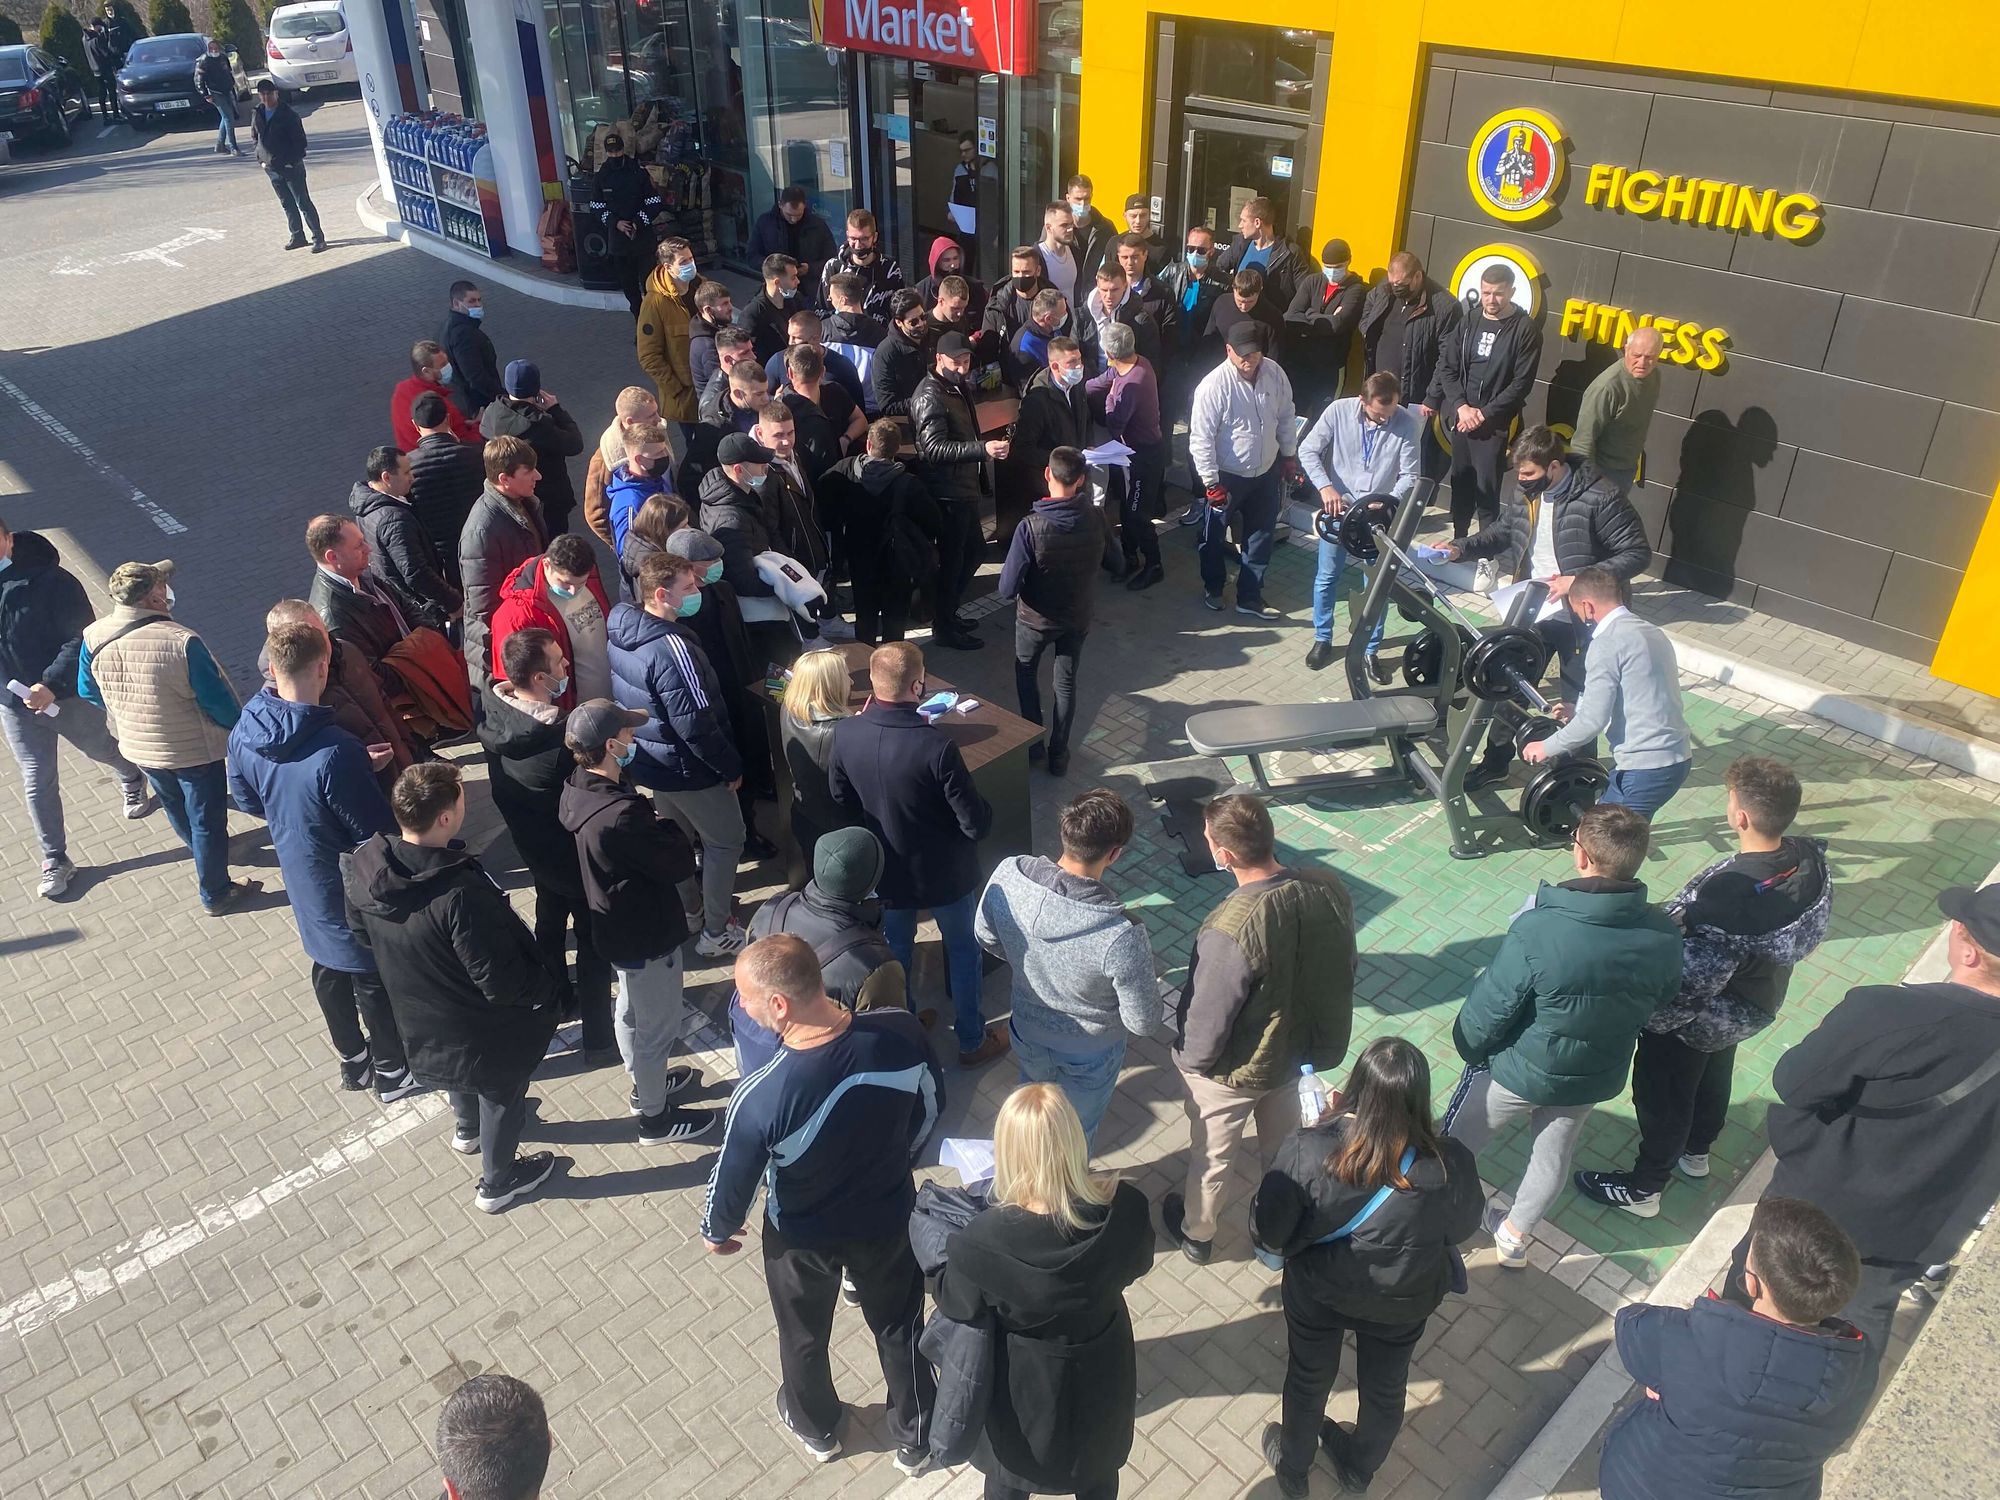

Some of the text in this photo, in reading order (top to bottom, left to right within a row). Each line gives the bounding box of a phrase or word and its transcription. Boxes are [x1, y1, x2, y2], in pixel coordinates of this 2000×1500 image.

[845, 0, 975, 57] Market
[1585, 164, 1822, 239] FIGHTING
[1480, 331, 1496, 345] 19
